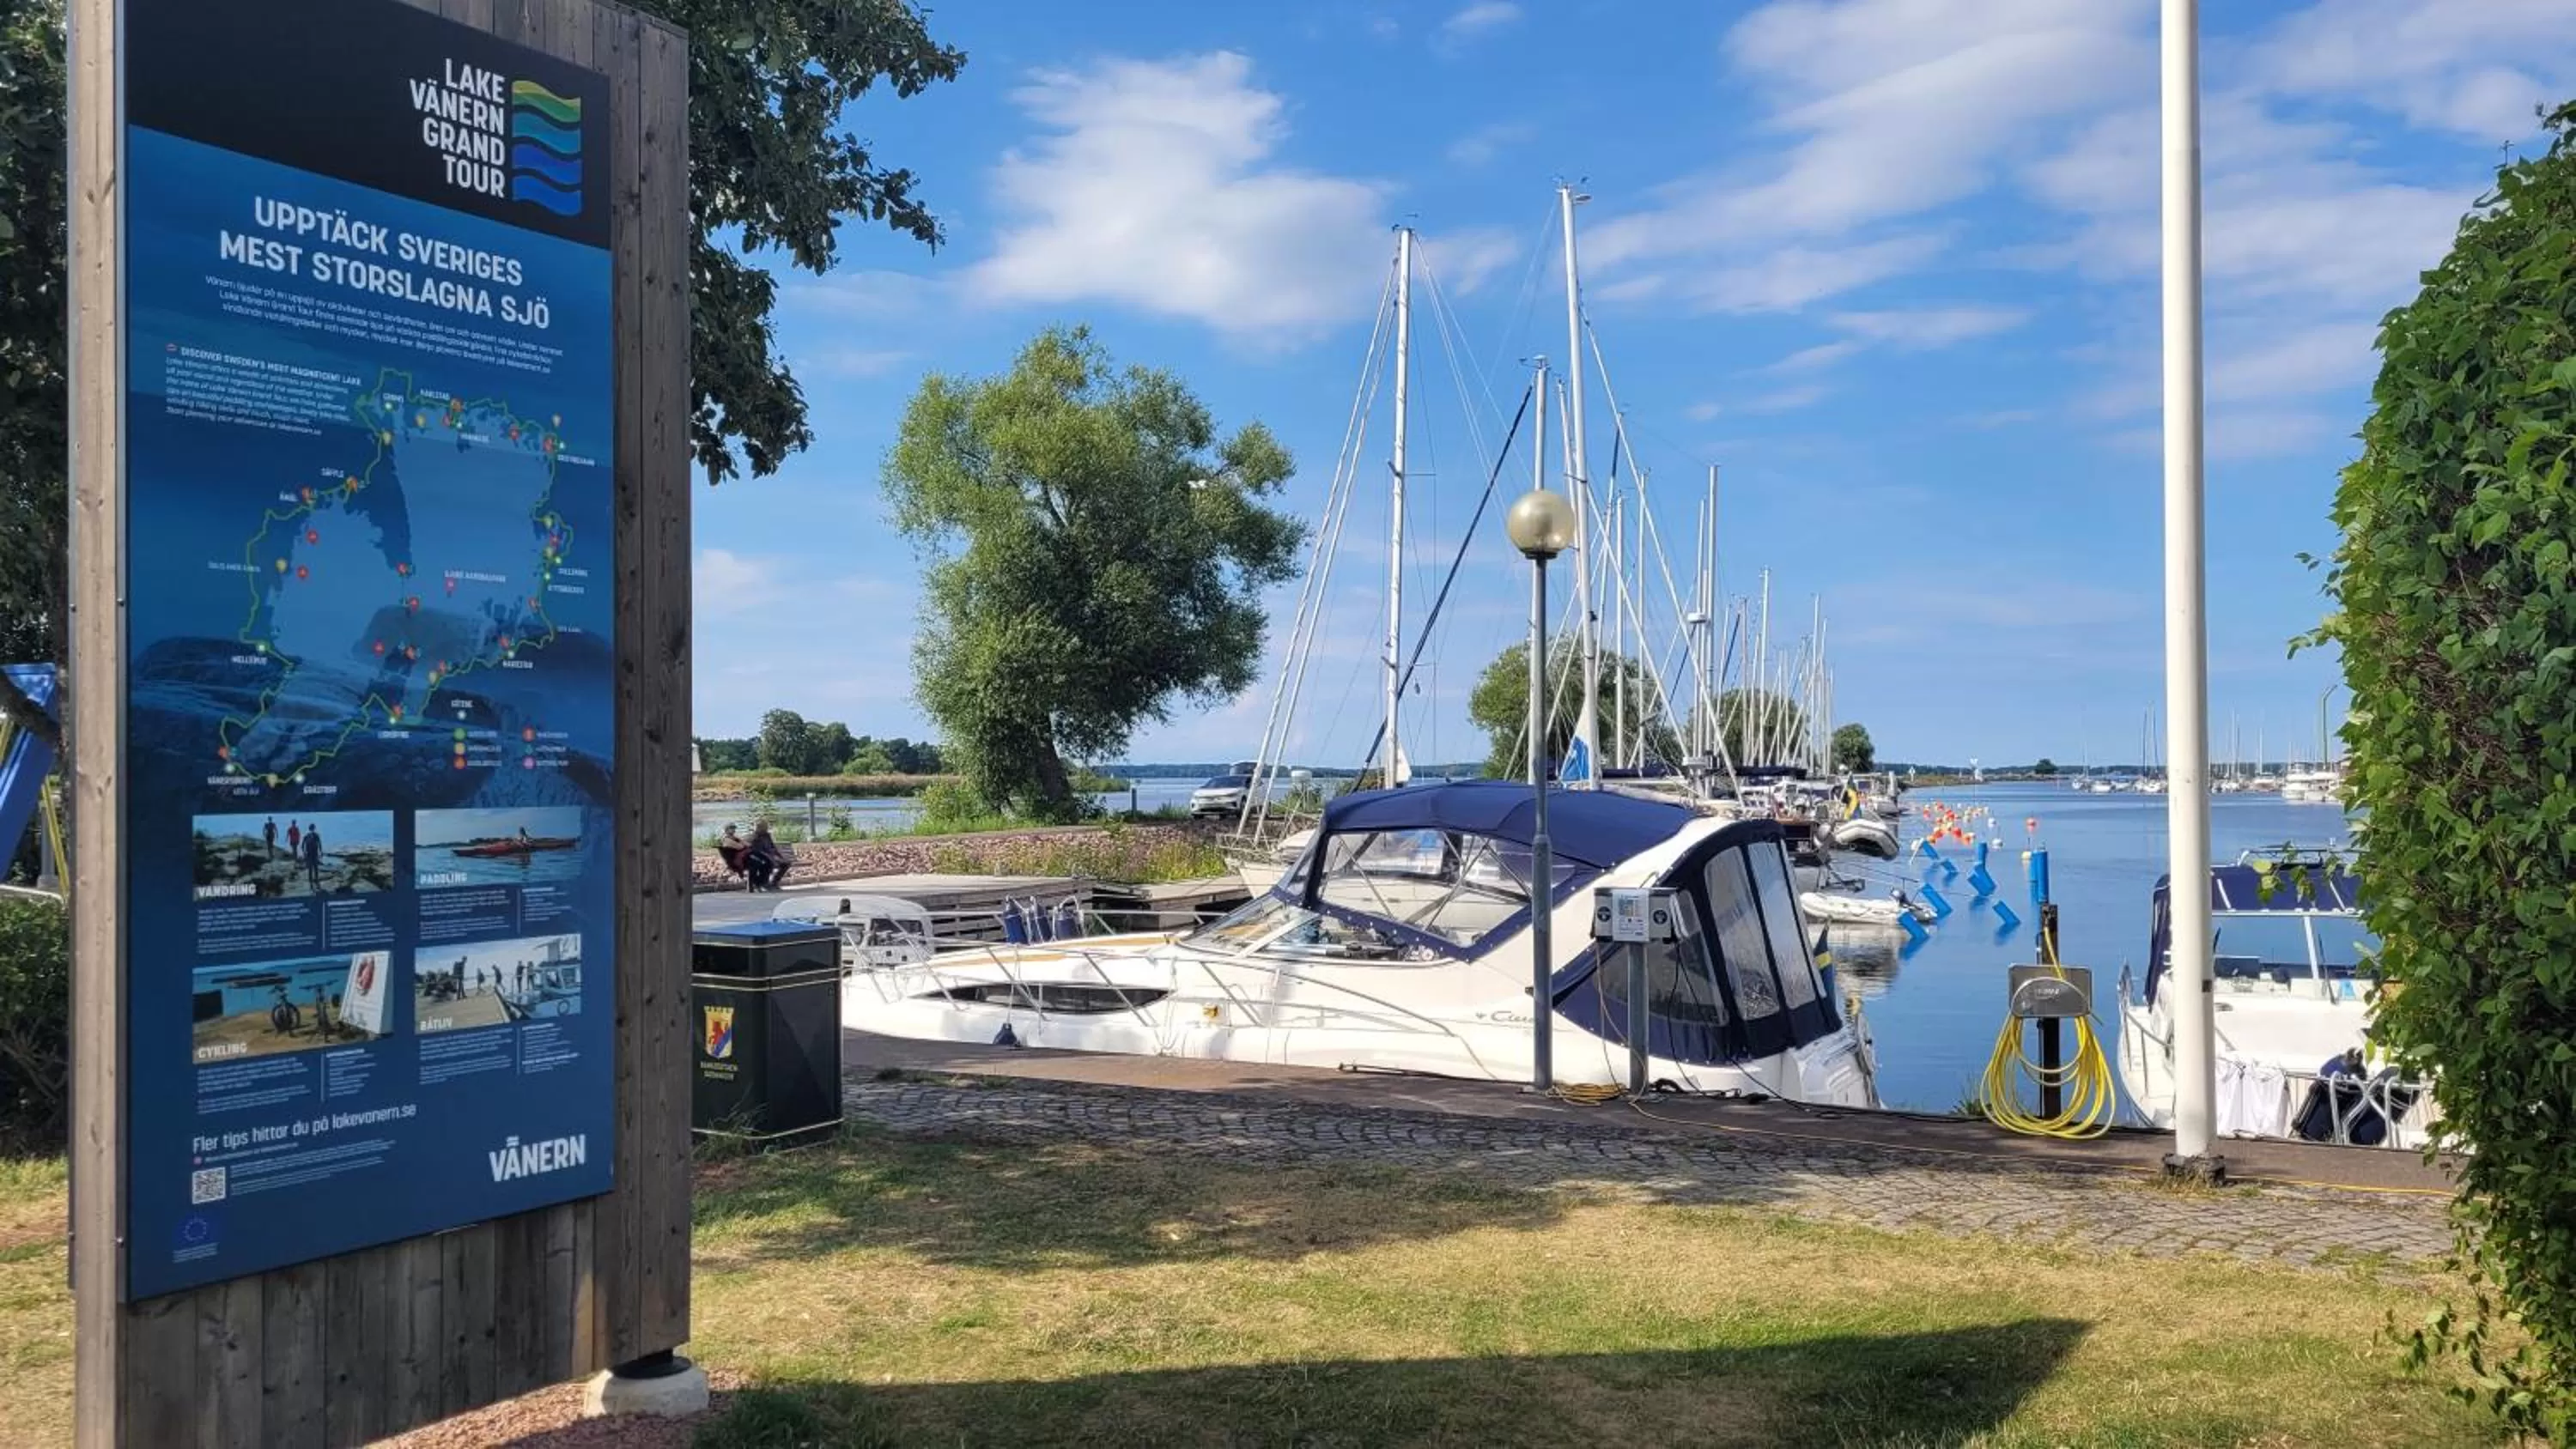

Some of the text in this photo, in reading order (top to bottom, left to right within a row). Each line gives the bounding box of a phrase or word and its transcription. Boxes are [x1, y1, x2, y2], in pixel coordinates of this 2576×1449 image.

[446, 58, 505, 104] LAKE
[410, 78, 505, 136] VÄNERN
[423, 117, 506, 166] GRAND
[442, 154, 505, 197] TOUR
[254, 196, 523, 286] UPPTÄCK SVERIGES
[220, 230, 550, 330] MEST STORSLAGNA SJÖ
[198, 884, 257, 899] VANDRING
[192, 1137, 218, 1155] Fler
[222, 1131, 249, 1150] tips
[252, 1125, 289, 1143] hittar
[293, 1119, 310, 1137] du
[313, 1116, 330, 1136] på
